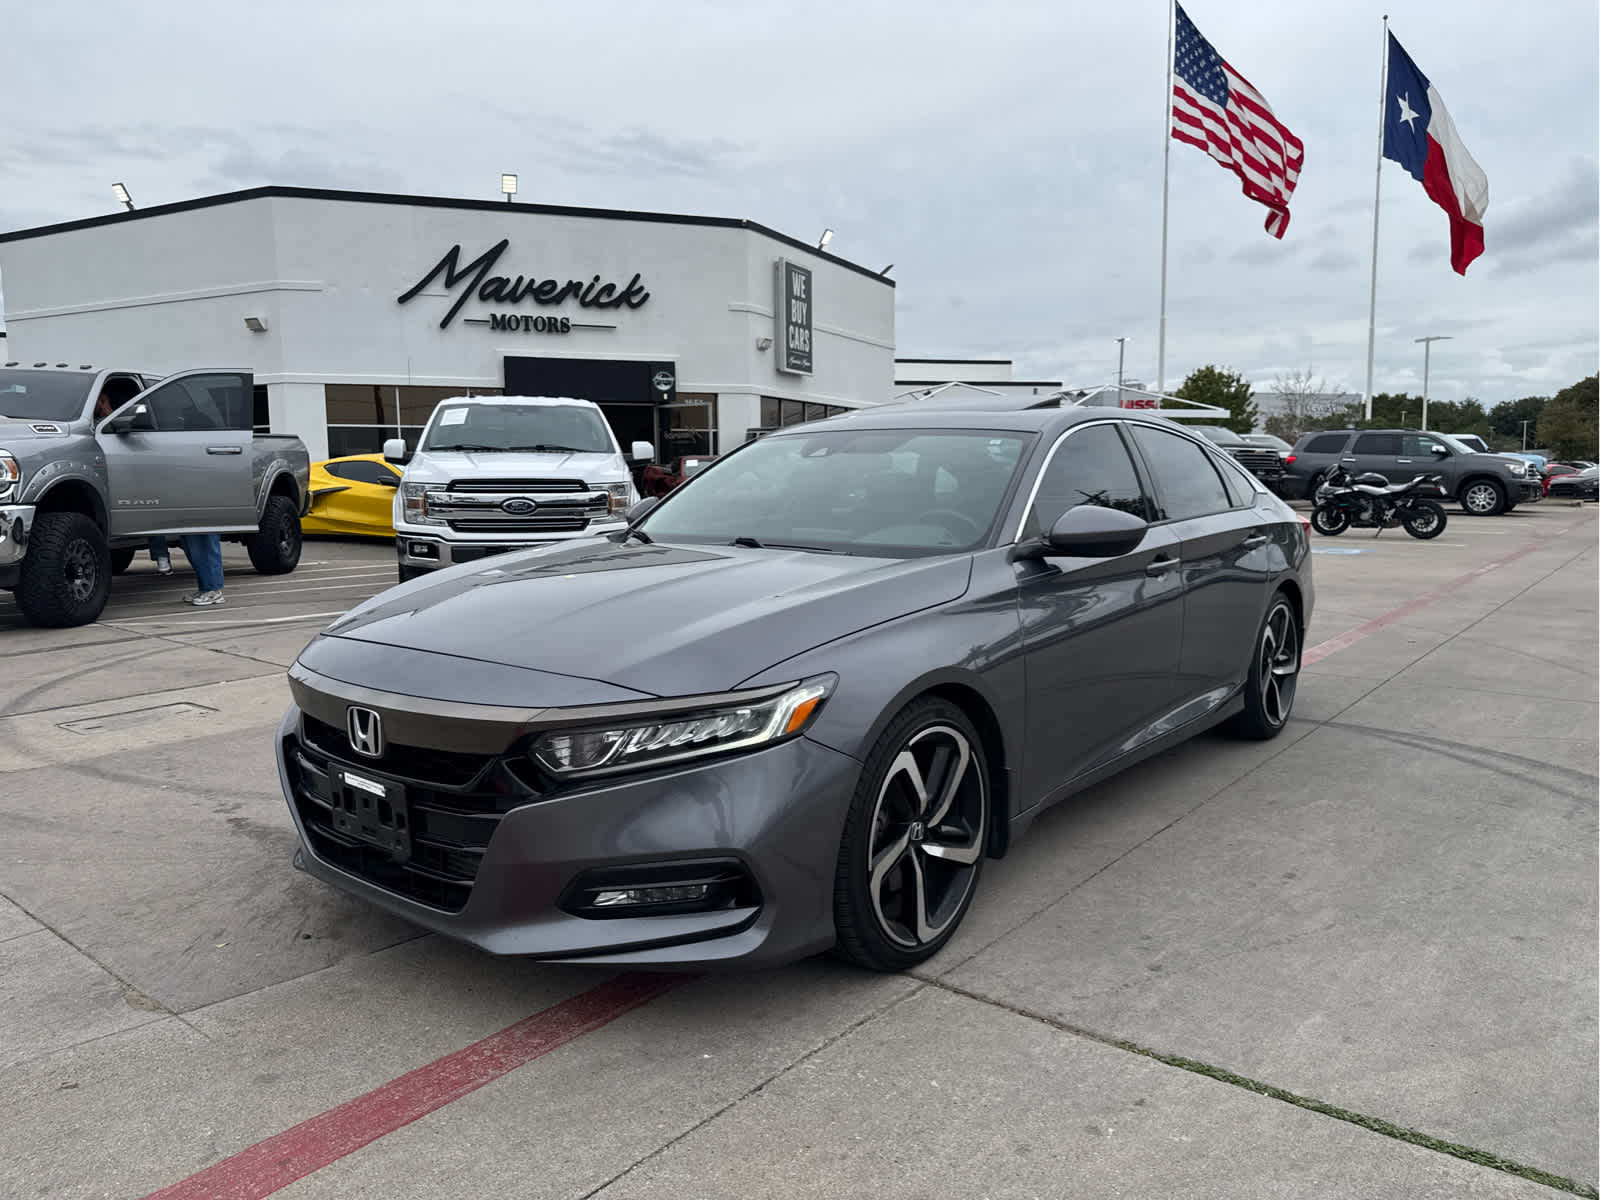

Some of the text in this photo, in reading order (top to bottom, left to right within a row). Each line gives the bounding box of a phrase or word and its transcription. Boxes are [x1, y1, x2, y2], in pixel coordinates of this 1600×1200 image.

[397, 238, 650, 329] Maverick
[792, 272, 806, 298] WE
[489, 313, 572, 334] MOTORS
[791, 299, 807, 325] BUY
[789, 325, 810, 353] CARS
